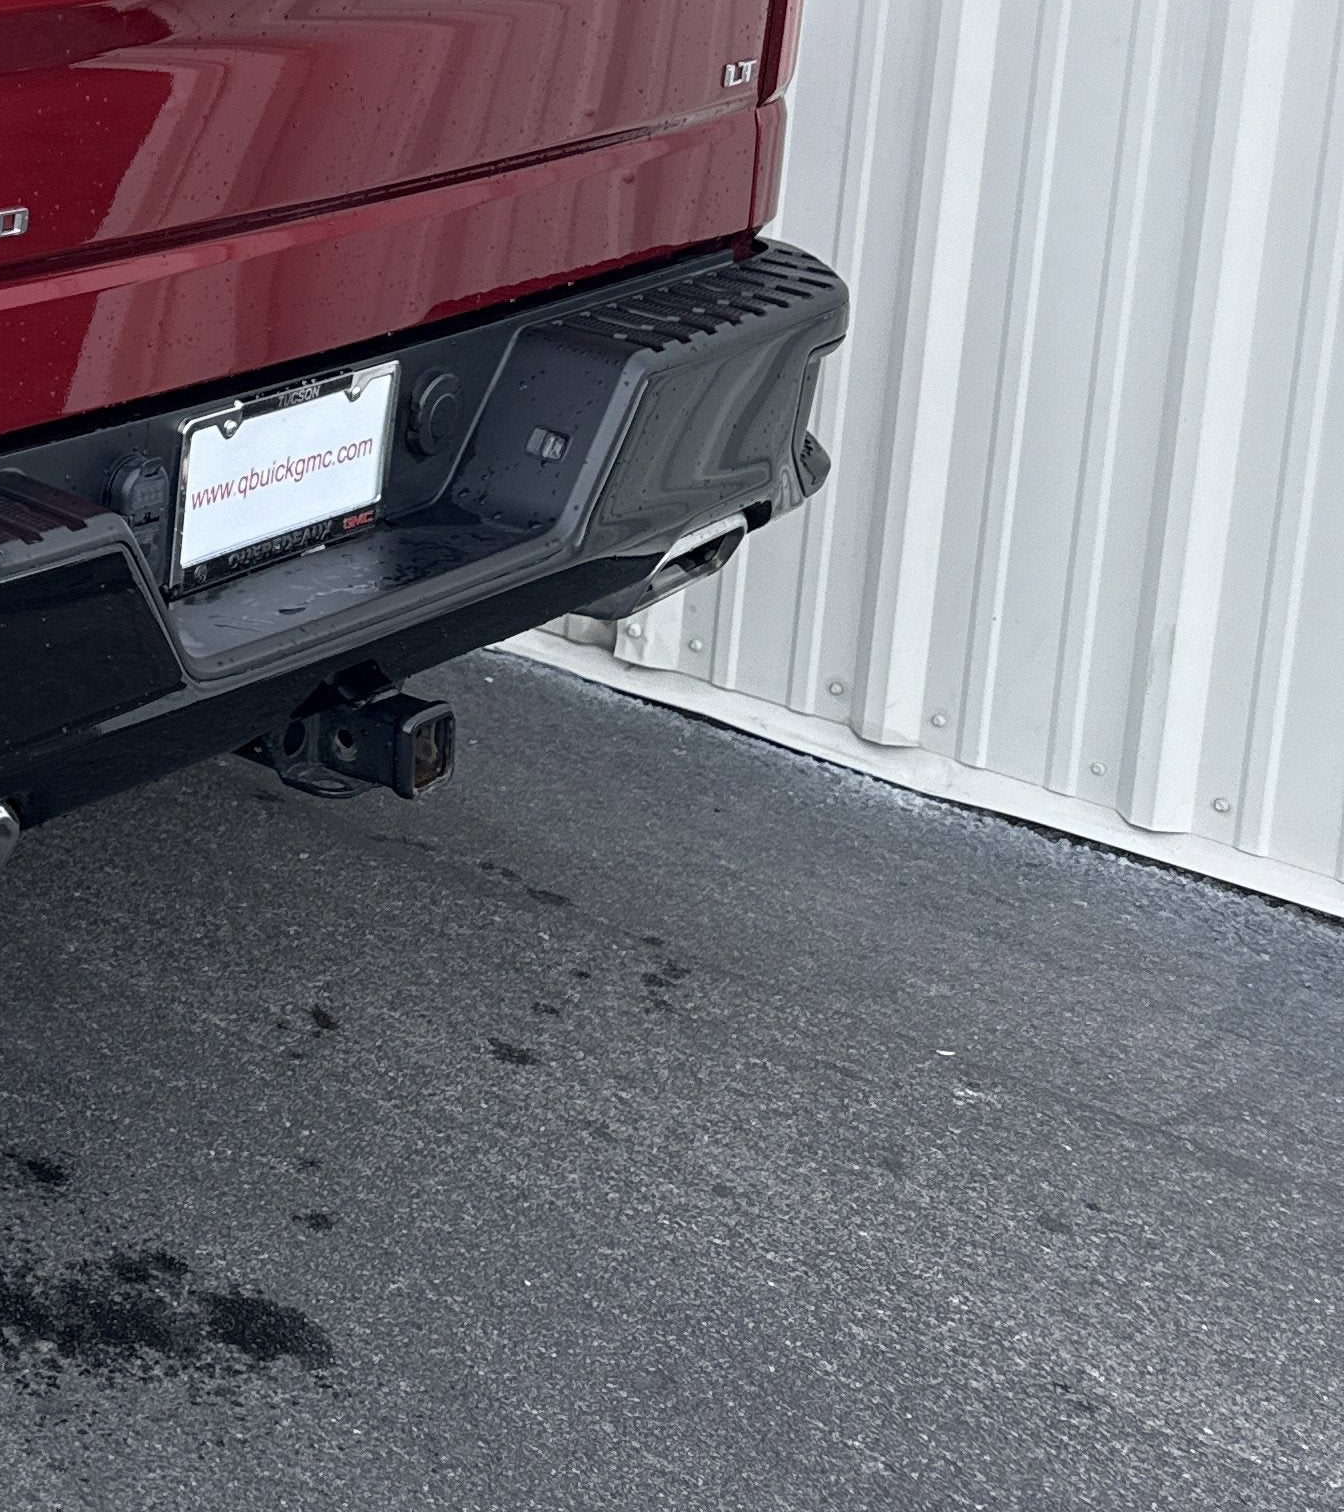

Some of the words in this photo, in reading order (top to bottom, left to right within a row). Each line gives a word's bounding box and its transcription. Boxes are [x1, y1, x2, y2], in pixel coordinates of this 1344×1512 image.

[722, 59, 758, 88] LT
[277, 385, 321, 409] TUCSON
[190, 436, 374, 511] www.qbuickgmc.com
